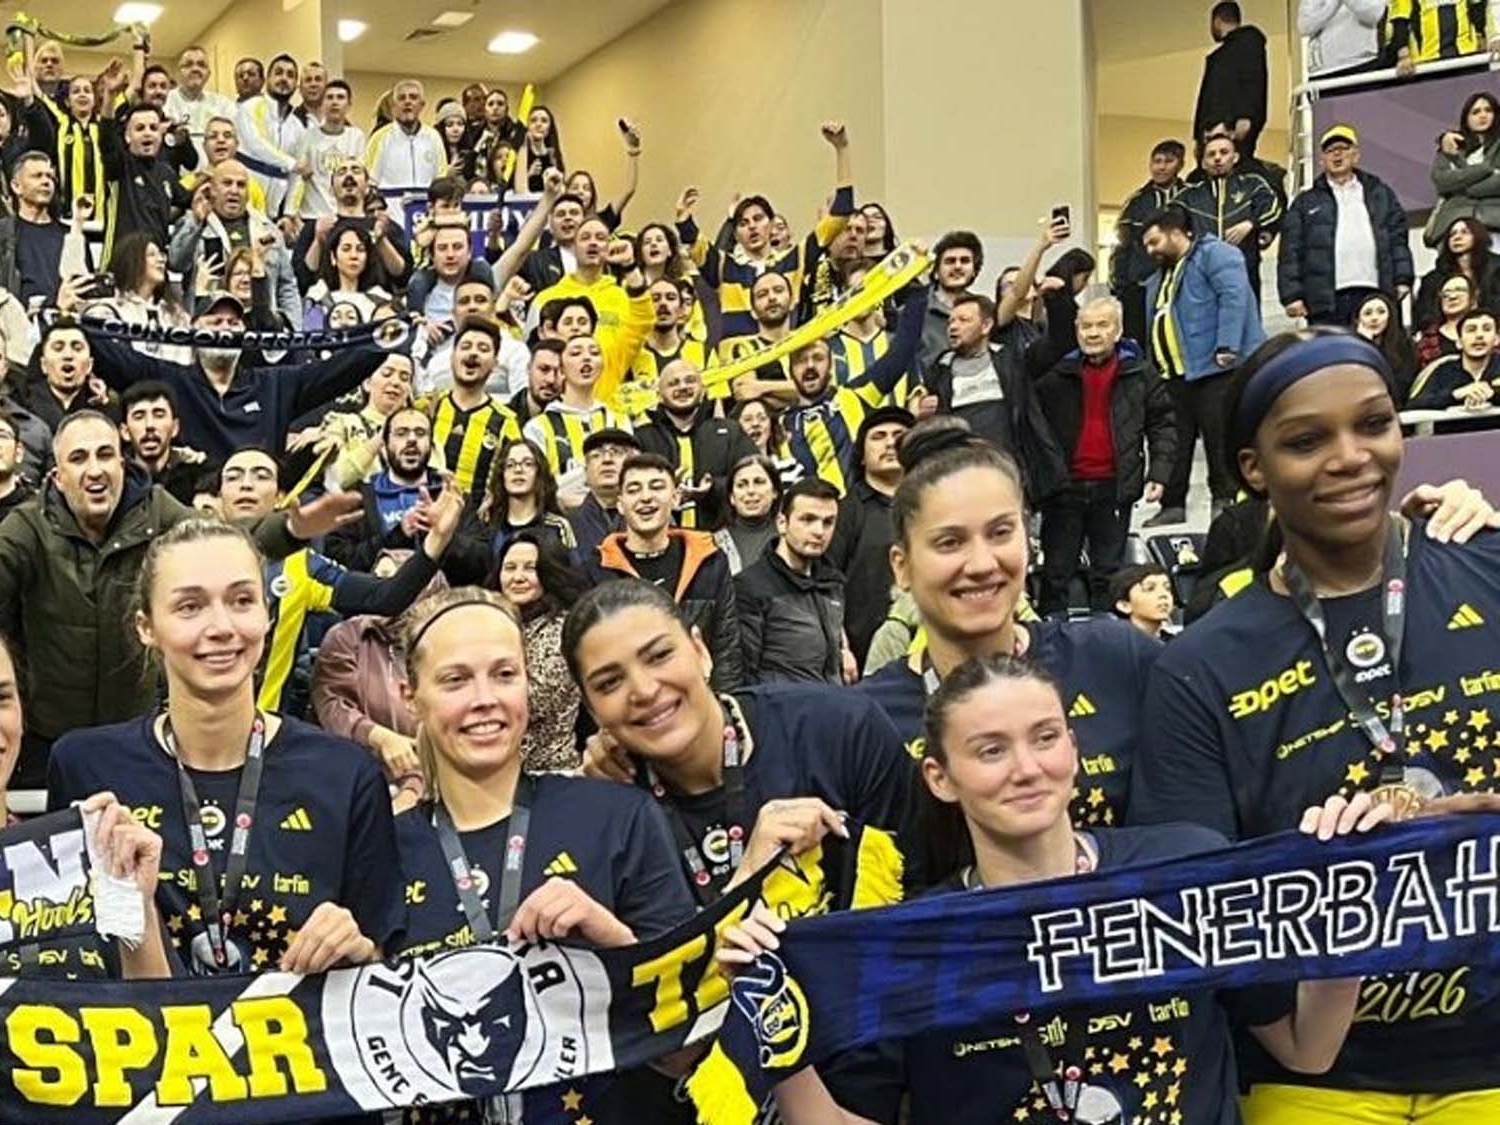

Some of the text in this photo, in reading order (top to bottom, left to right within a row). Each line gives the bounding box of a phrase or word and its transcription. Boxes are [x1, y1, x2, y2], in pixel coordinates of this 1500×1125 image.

[1027, 834, 1500, 993] FENERBAH
[4, 995, 328, 1108] SPAR
[1356, 966, 1472, 1025] 2026
